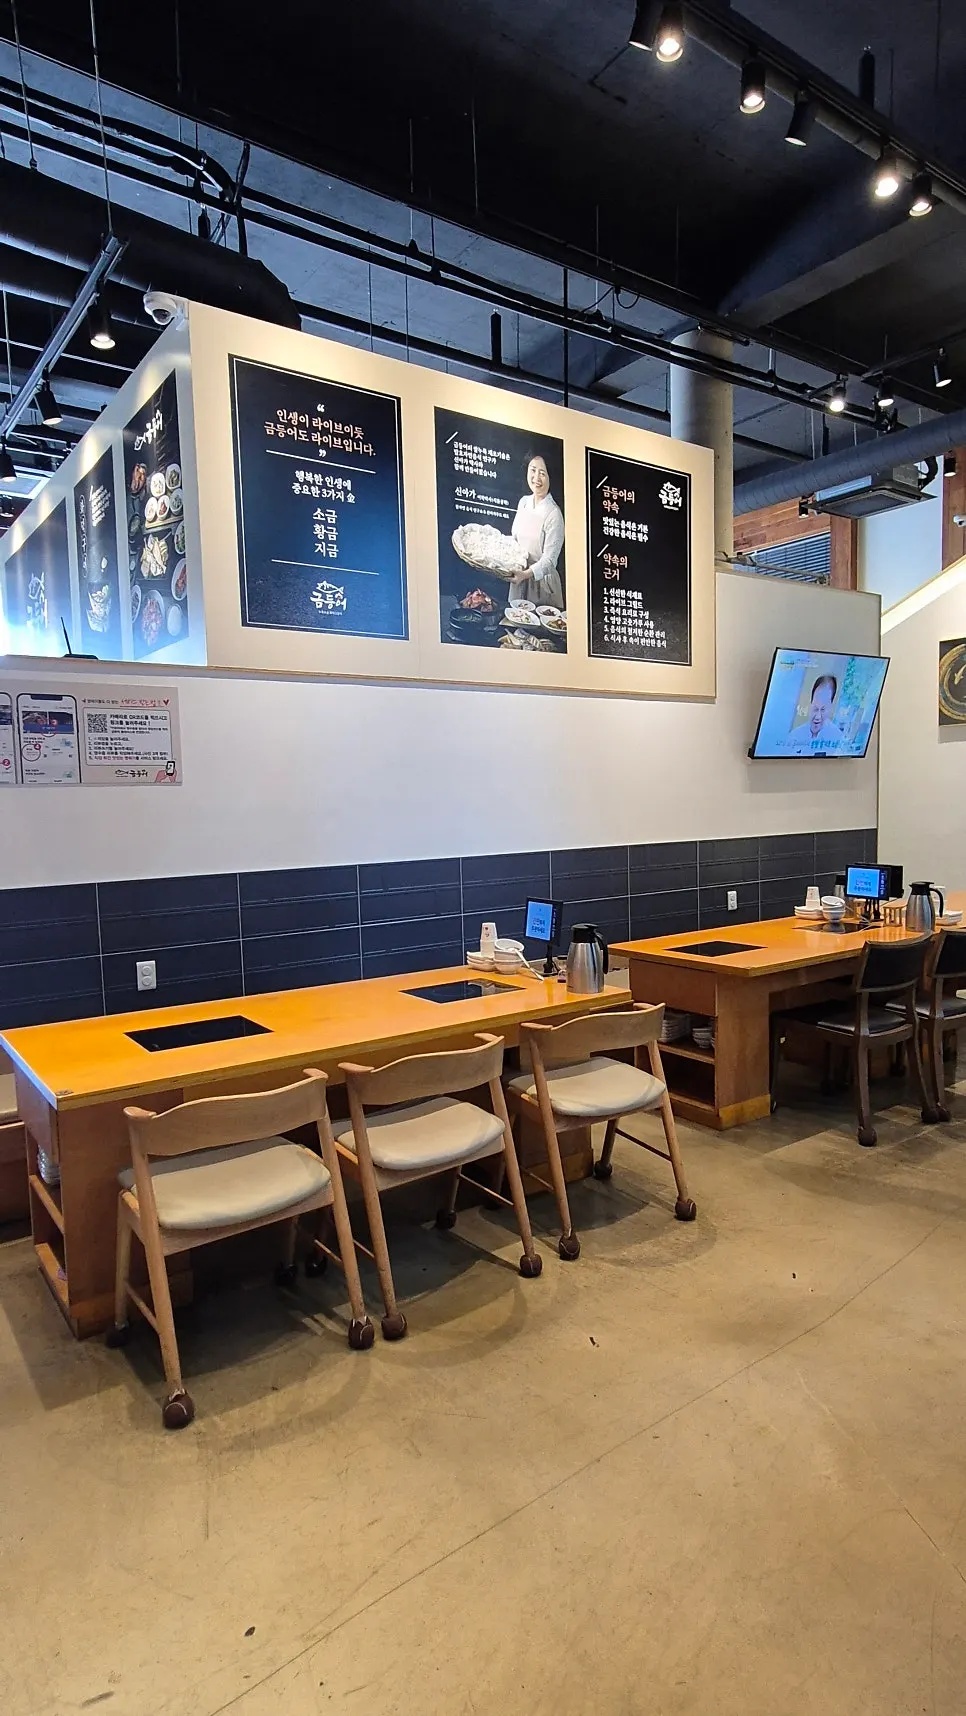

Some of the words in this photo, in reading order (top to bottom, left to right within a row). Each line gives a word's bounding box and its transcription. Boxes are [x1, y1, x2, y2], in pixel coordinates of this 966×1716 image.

[277, 409, 309, 428] 인생이
[312, 417, 364, 439] 라이브이듯
[264, 421, 309, 441] 금등어도
[311, 432, 376, 456] 라이브입니다.
[454, 442, 473, 452] 금등어의
[295, 470, 324, 486] 행복한
[325, 476, 352, 491] 인생에
[292, 482, 321, 498] 중요한
[322, 488, 345, 503] 3가지
[455, 487, 476, 500] 신아가
[602, 485, 635, 504] 금등어의
[603, 500, 620, 514] 약속
[313, 508, 338, 524] 소금
[313, 524, 339, 541] 황금
[602, 516, 620, 528] 맛있는
[621, 520, 637, 532] 음식은
[637, 524, 649, 534] 기본
[603, 526, 620, 537] 건강한
[621, 529, 637, 541] 음식은
[637, 533, 649, 543] 필수
[314, 542, 339, 558] 지금
[603, 553, 628, 568] 약속의
[603, 568, 620, 581] 근거
[310, 591, 347, 611] 금등어
[610, 588, 626, 598] 신선한
[627, 590, 643, 600] 식재료
[610, 597, 626, 607] 라이브
[639, 611, 650, 620] 구성
[610, 625, 627, 636] 음식의
[644, 620, 654, 630] 사용
[622, 636, 628, 644] 후
[657, 640, 667, 649] 음식
